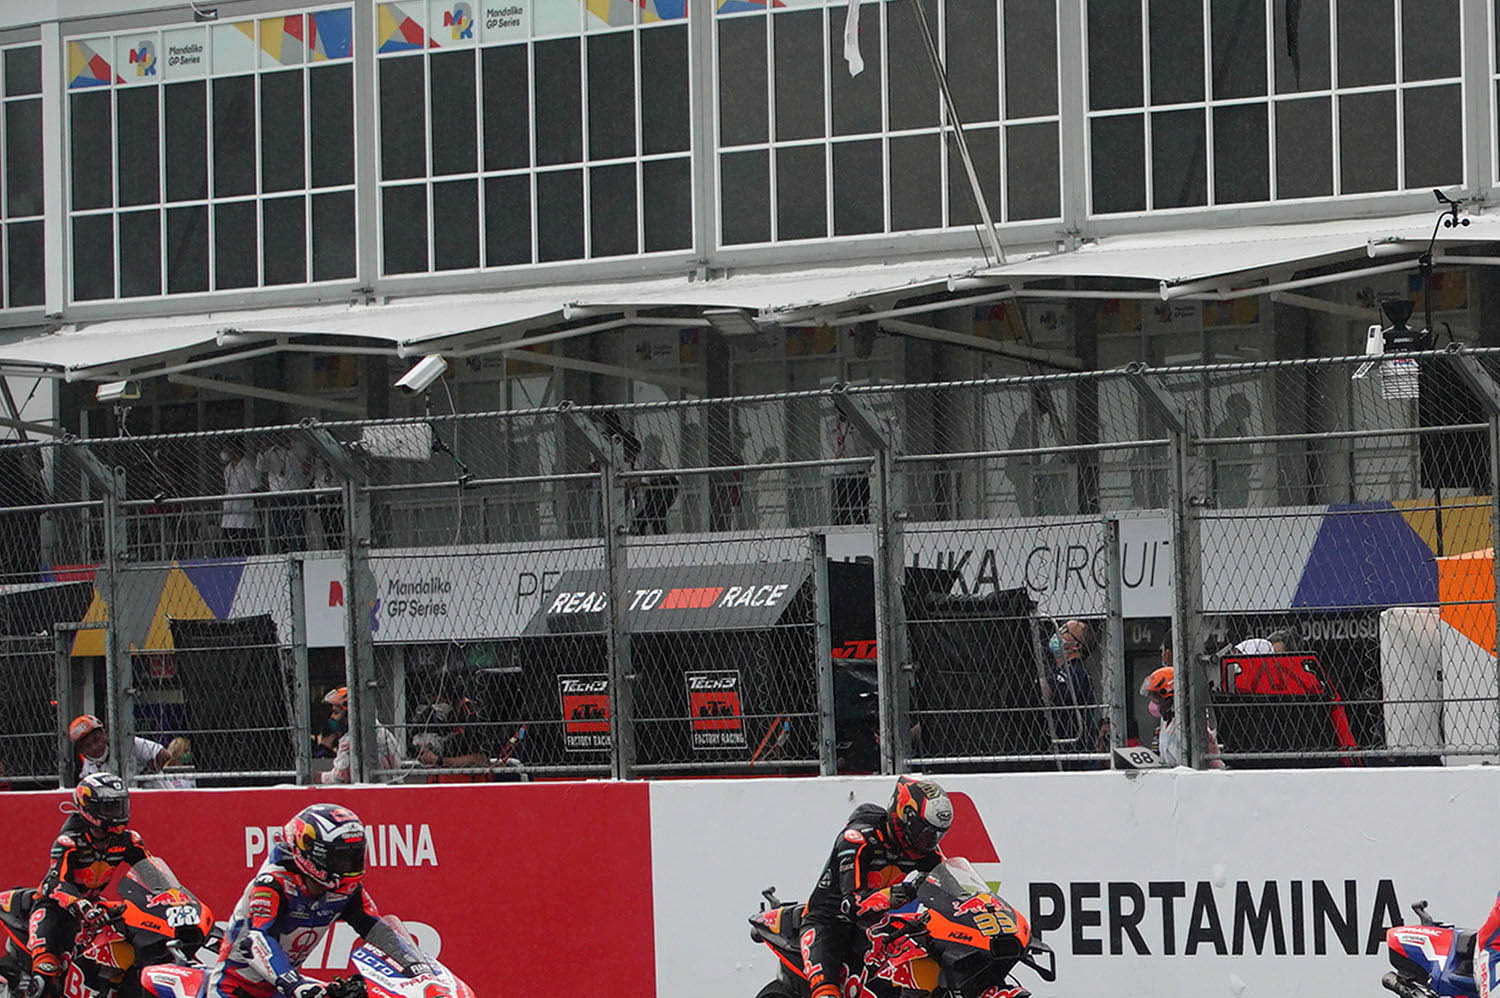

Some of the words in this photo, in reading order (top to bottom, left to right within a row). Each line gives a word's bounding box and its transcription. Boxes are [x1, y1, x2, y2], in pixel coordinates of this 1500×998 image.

[485, 6, 524, 18] Mandalika
[486, 20, 498, 29] GP
[498, 18, 520, 28] Series
[169, 44, 203, 55] Mandalika
[168, 57, 179, 66] GP
[180, 56, 201, 65] Series
[1024, 541, 1170, 592] CIRCUI
[387, 577, 450, 597] Mandalika
[628, 589, 662, 611] TO
[718, 584, 789, 608] RACE
[388, 601, 406, 617] GP
[409, 598, 447, 616] Series
[593, 734, 612, 745] RACIN
[1131, 751, 1154, 764] 88
[245, 823, 438, 867] PEMINA
[973, 912, 1017, 936] 33
[1028, 879, 1404, 956] PERTAMINA
